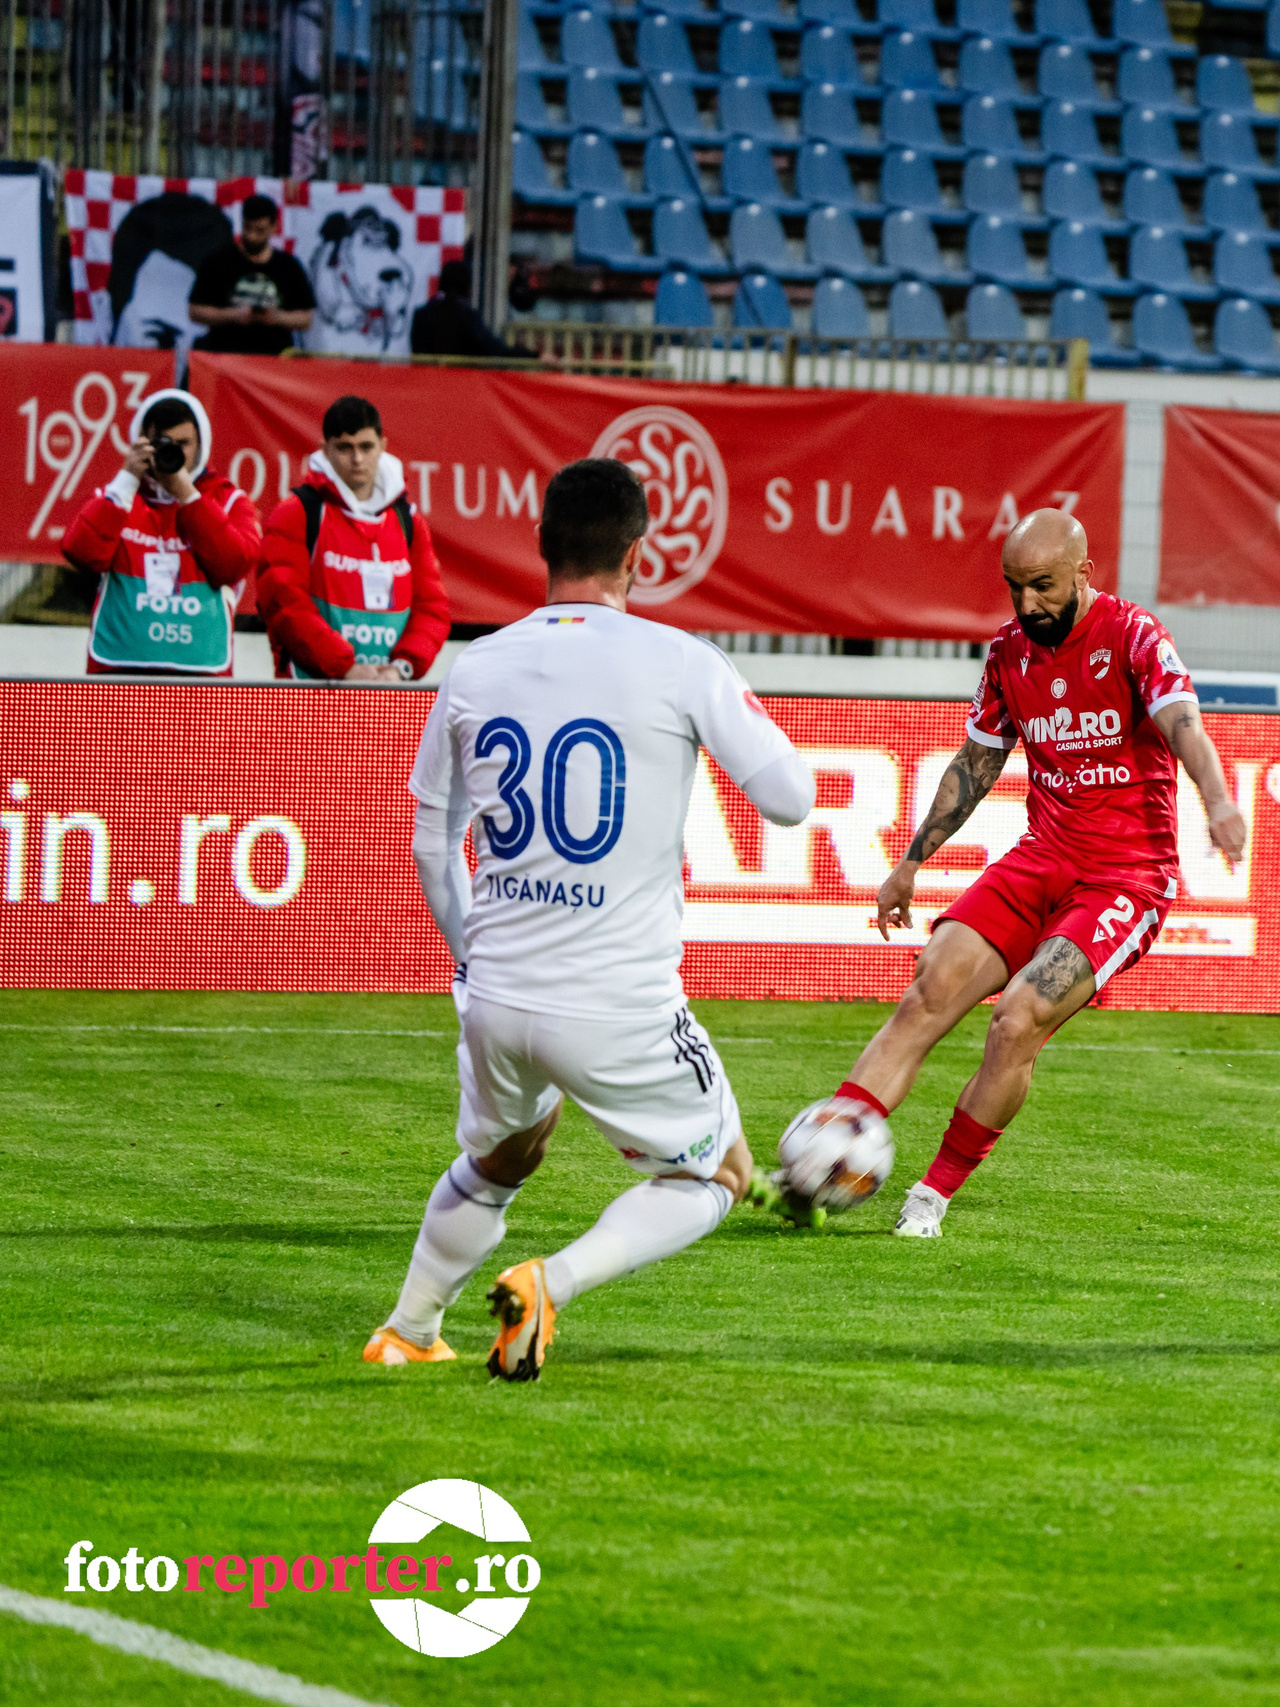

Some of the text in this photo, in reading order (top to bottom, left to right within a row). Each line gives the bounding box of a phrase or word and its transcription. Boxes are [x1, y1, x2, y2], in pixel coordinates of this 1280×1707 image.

[136, 592, 202, 616] FOTO
[148, 621, 194, 644] 055
[341, 623, 398, 647] FOTO
[1055, 739, 1084, 752] CASINO
[1092, 736, 1123, 748] SPORT
[474, 716, 627, 865] 30
